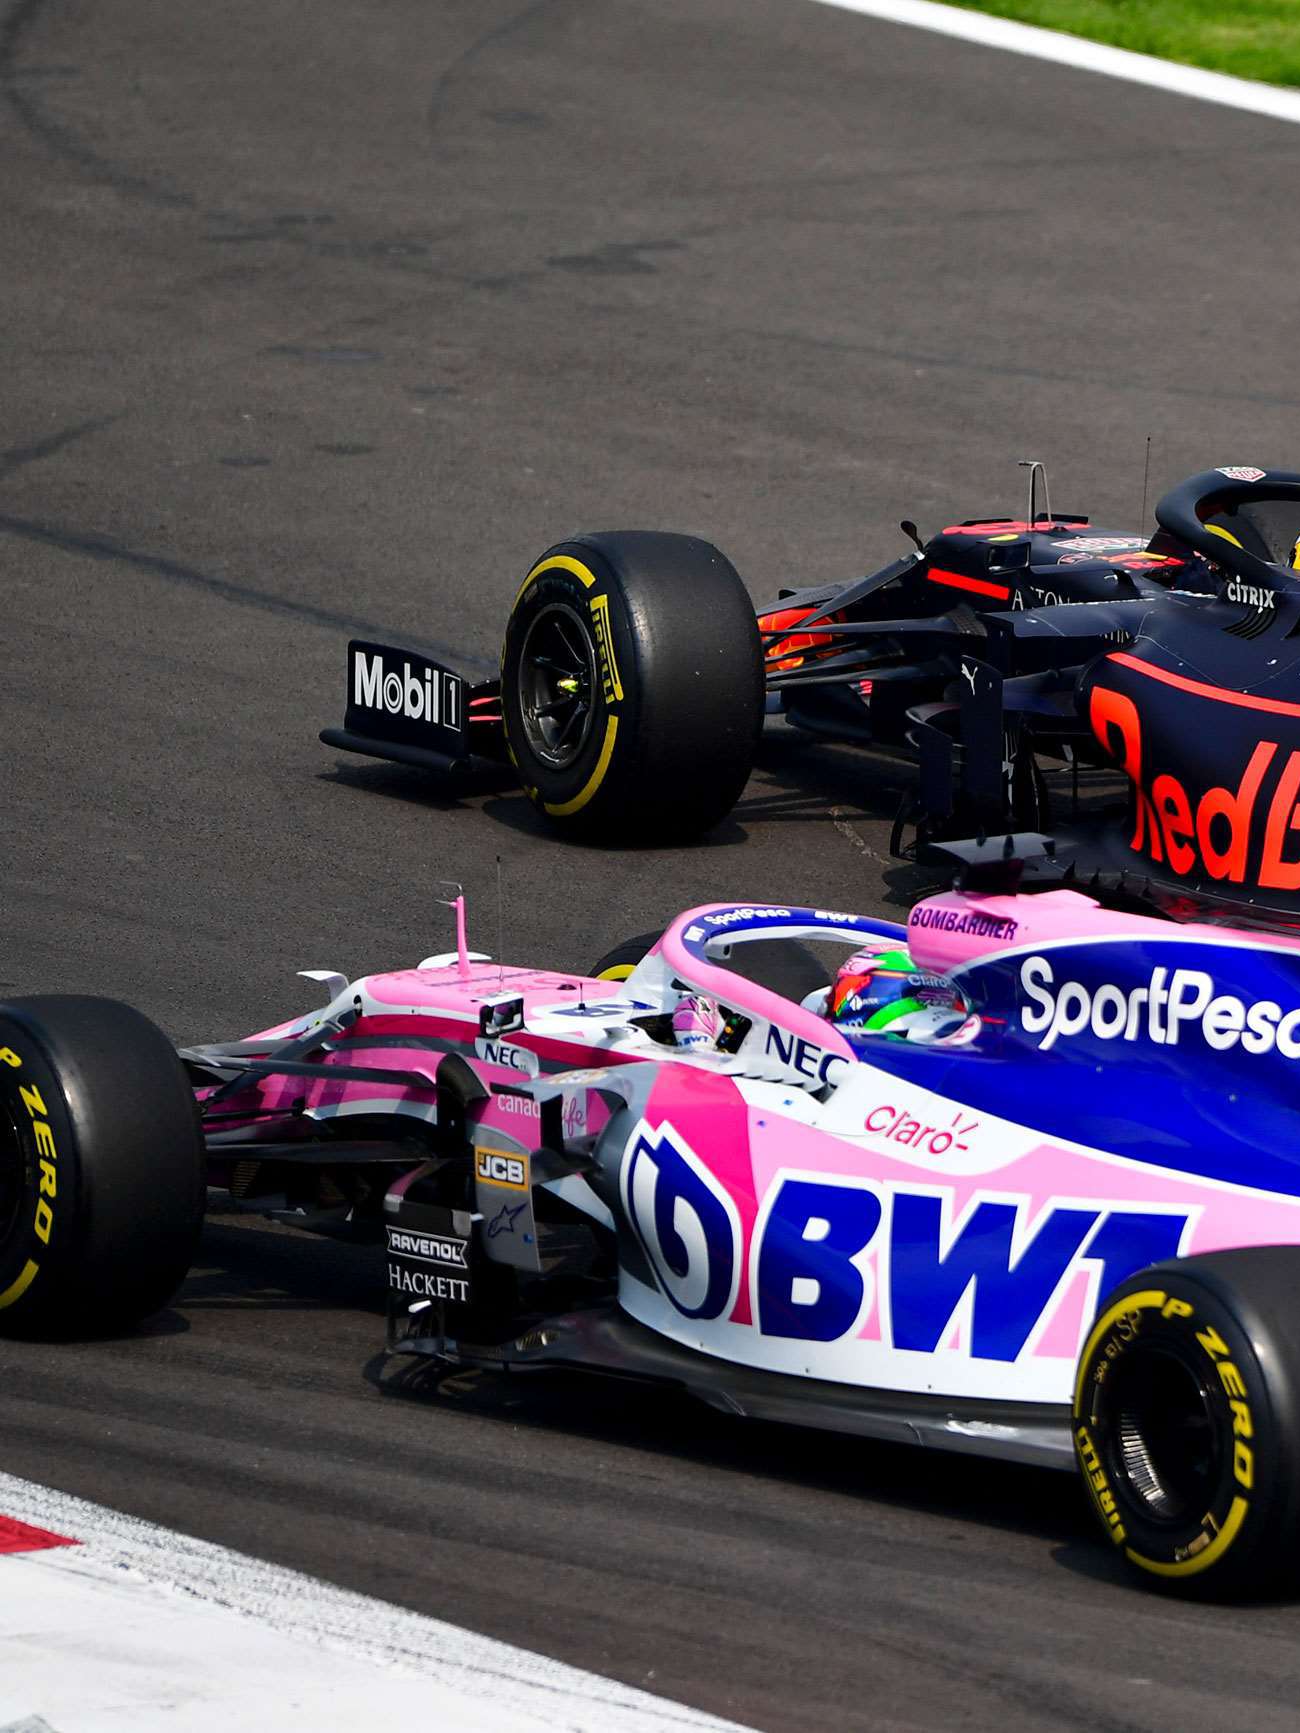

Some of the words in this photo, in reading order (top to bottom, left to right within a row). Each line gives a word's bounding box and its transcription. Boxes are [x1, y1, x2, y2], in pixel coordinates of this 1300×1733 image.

[1012, 589, 1071, 611] ATON
[354, 651, 439, 724] Mobil
[1090, 686, 1278, 884] Red
[704, 908, 791, 925] SportPesa
[814, 911, 858, 923] BWT
[909, 907, 1018, 941] BOMBARDIER
[484, 1044, 519, 1069] NEC
[766, 1023, 850, 1091] NEC
[497, 1094, 541, 1118] canad
[563, 1097, 586, 1137] ife
[864, 1105, 954, 1155] Claro
[19, 1084, 57, 1244] ZERO
[477, 1157, 525, 1183] JCB
[391, 1233, 463, 1262] RAVENOL
[388, 1263, 469, 1301] HACKETT
[759, 1180, 1189, 1363] BWT
[1161, 1298, 1194, 1320] P
[1195, 1326, 1255, 1490] ZERO
[1074, 1426, 1128, 1546] PIRELLI
